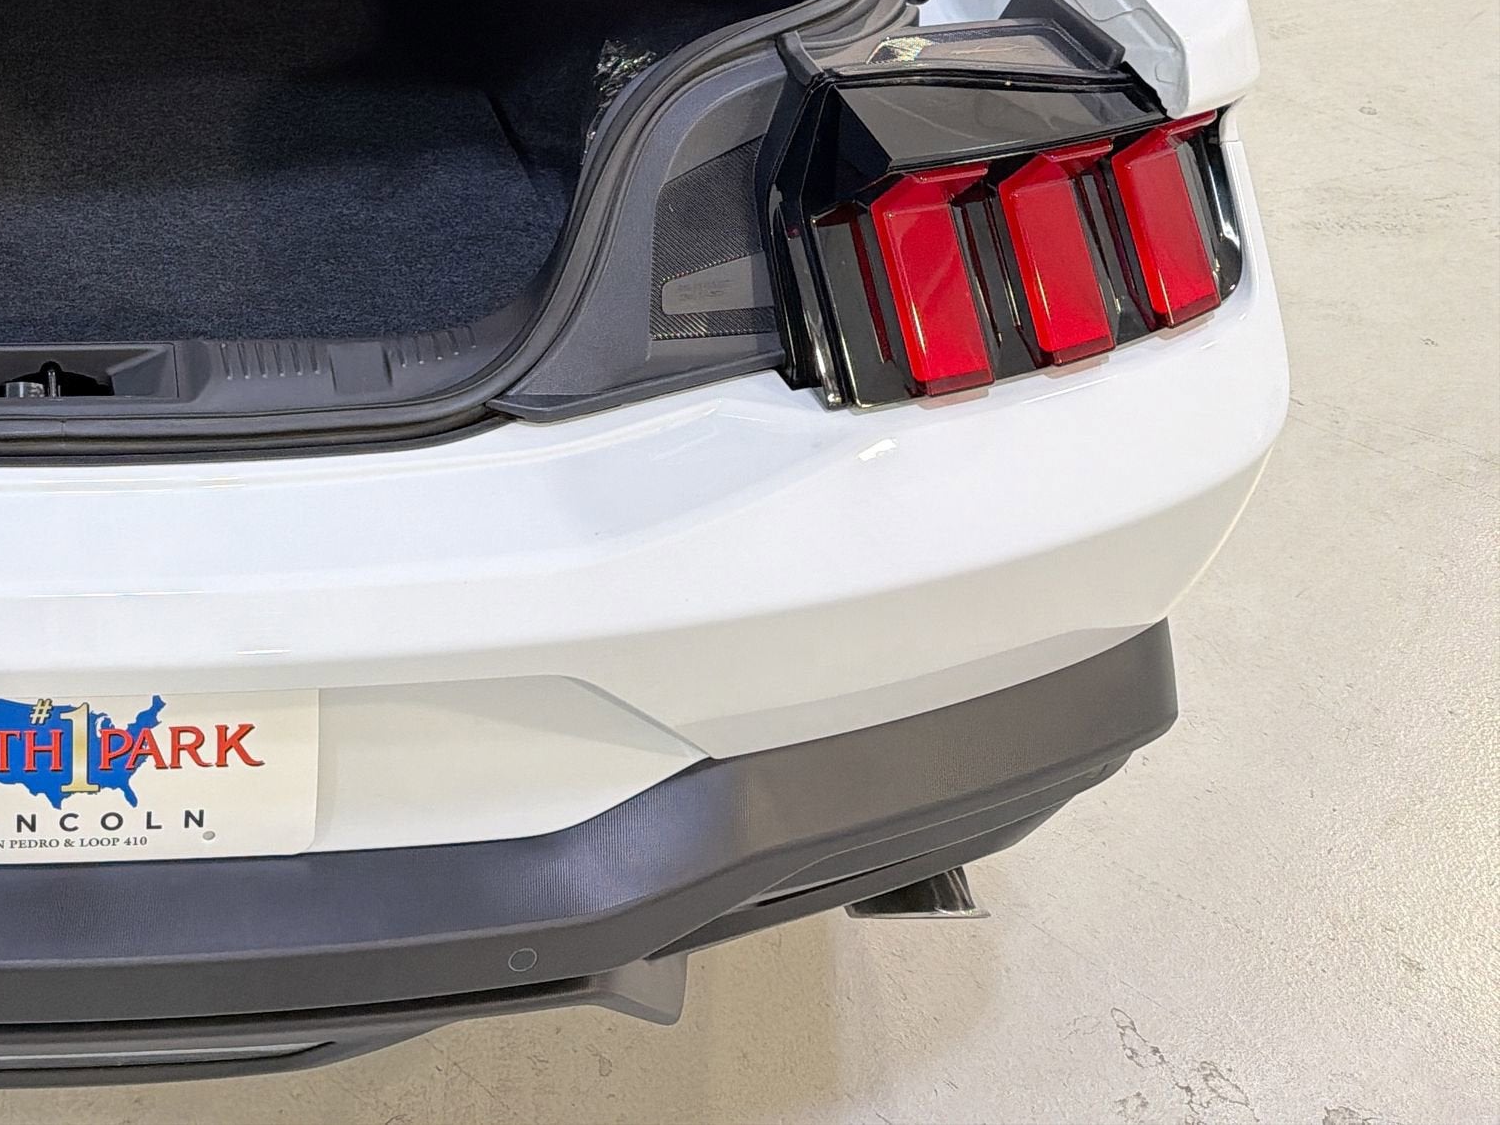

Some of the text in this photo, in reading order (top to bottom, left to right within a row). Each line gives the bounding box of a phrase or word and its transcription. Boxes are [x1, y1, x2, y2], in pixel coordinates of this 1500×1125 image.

[98, 723, 266, 770] PARK
[9, 838, 60, 849] PEDRO
[63, 837, 76, 848] &
[79, 836, 121, 848] LOOP
[123, 835, 149, 847] 410
